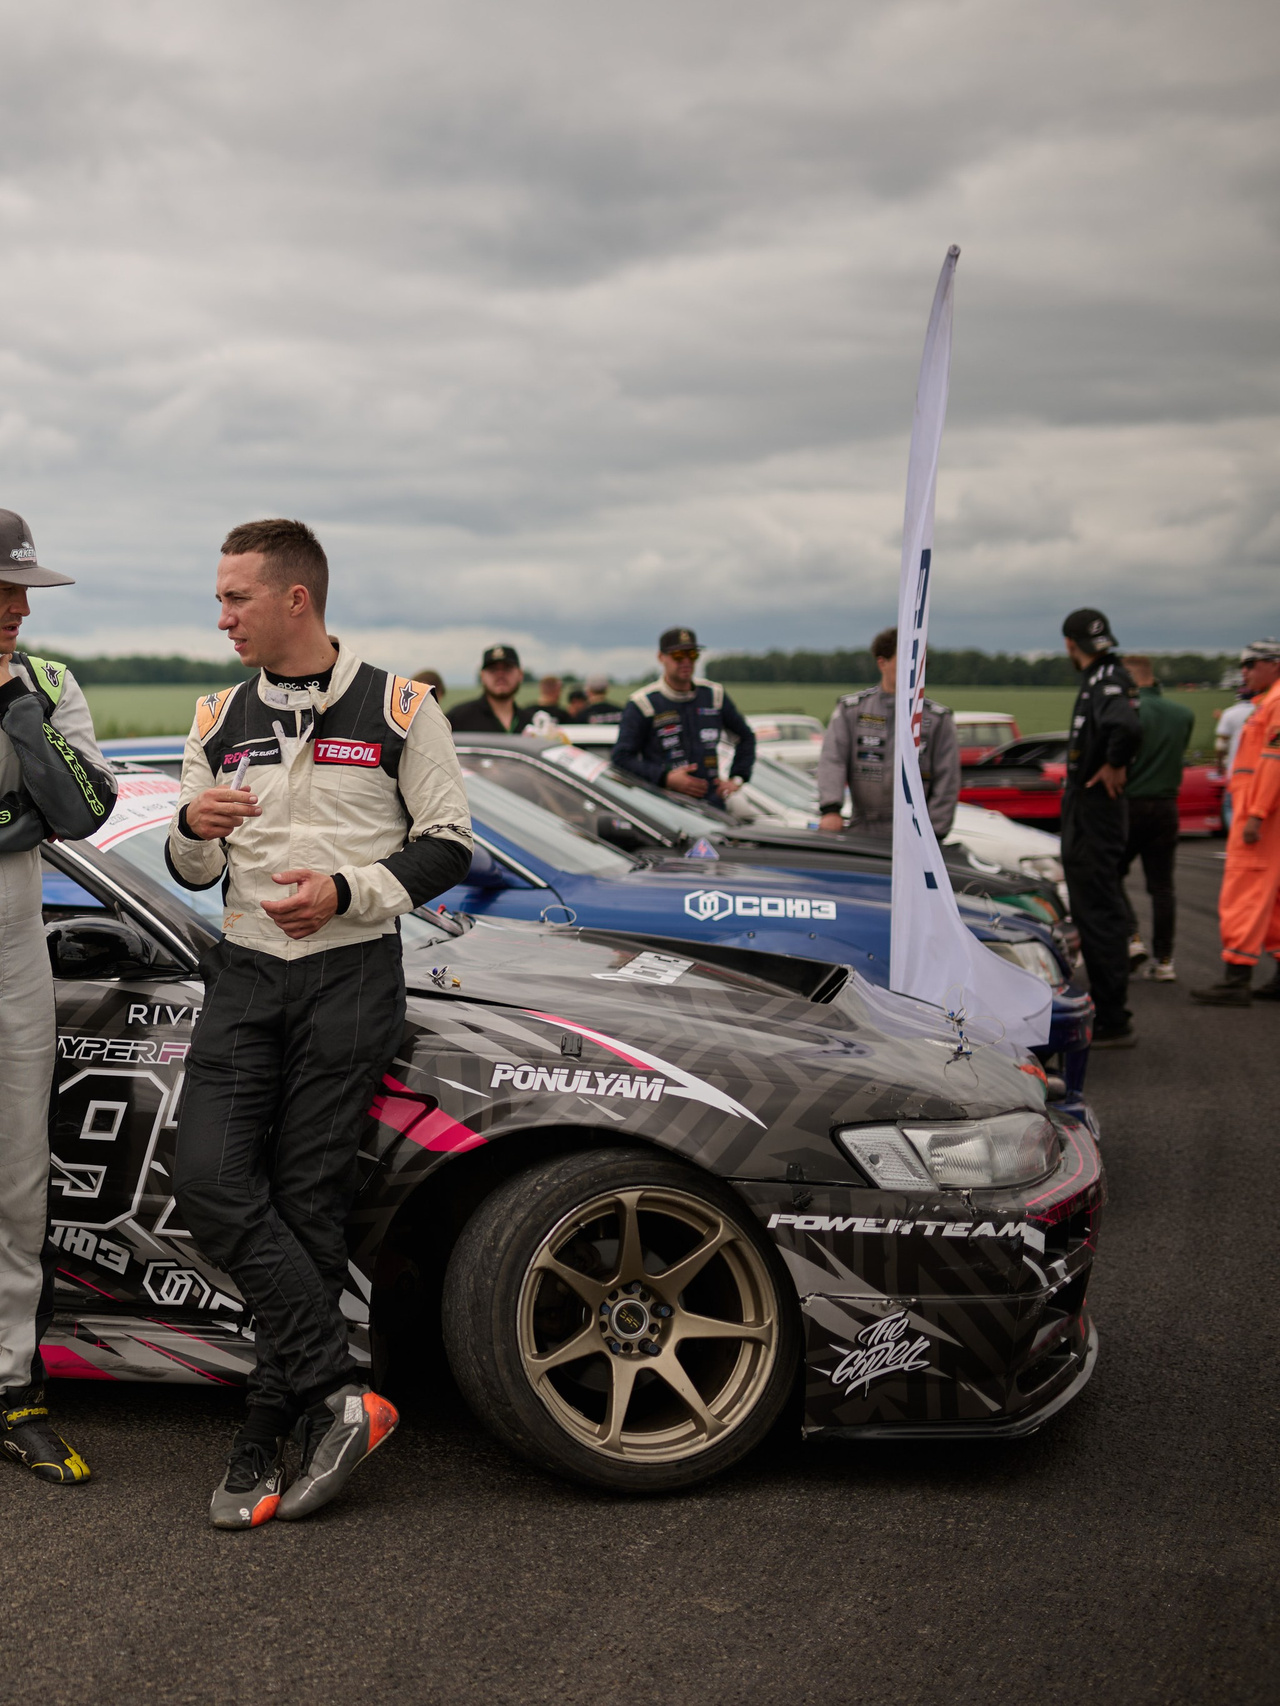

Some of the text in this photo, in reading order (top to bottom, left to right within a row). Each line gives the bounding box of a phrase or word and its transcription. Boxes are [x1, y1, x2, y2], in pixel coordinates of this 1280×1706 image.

[317, 743, 377, 762] TEBOIL
[42, 723, 105, 817] alpinestars
[735, 895, 837, 920] СОЮЗ
[490, 1063, 666, 1102] PONULYAM
